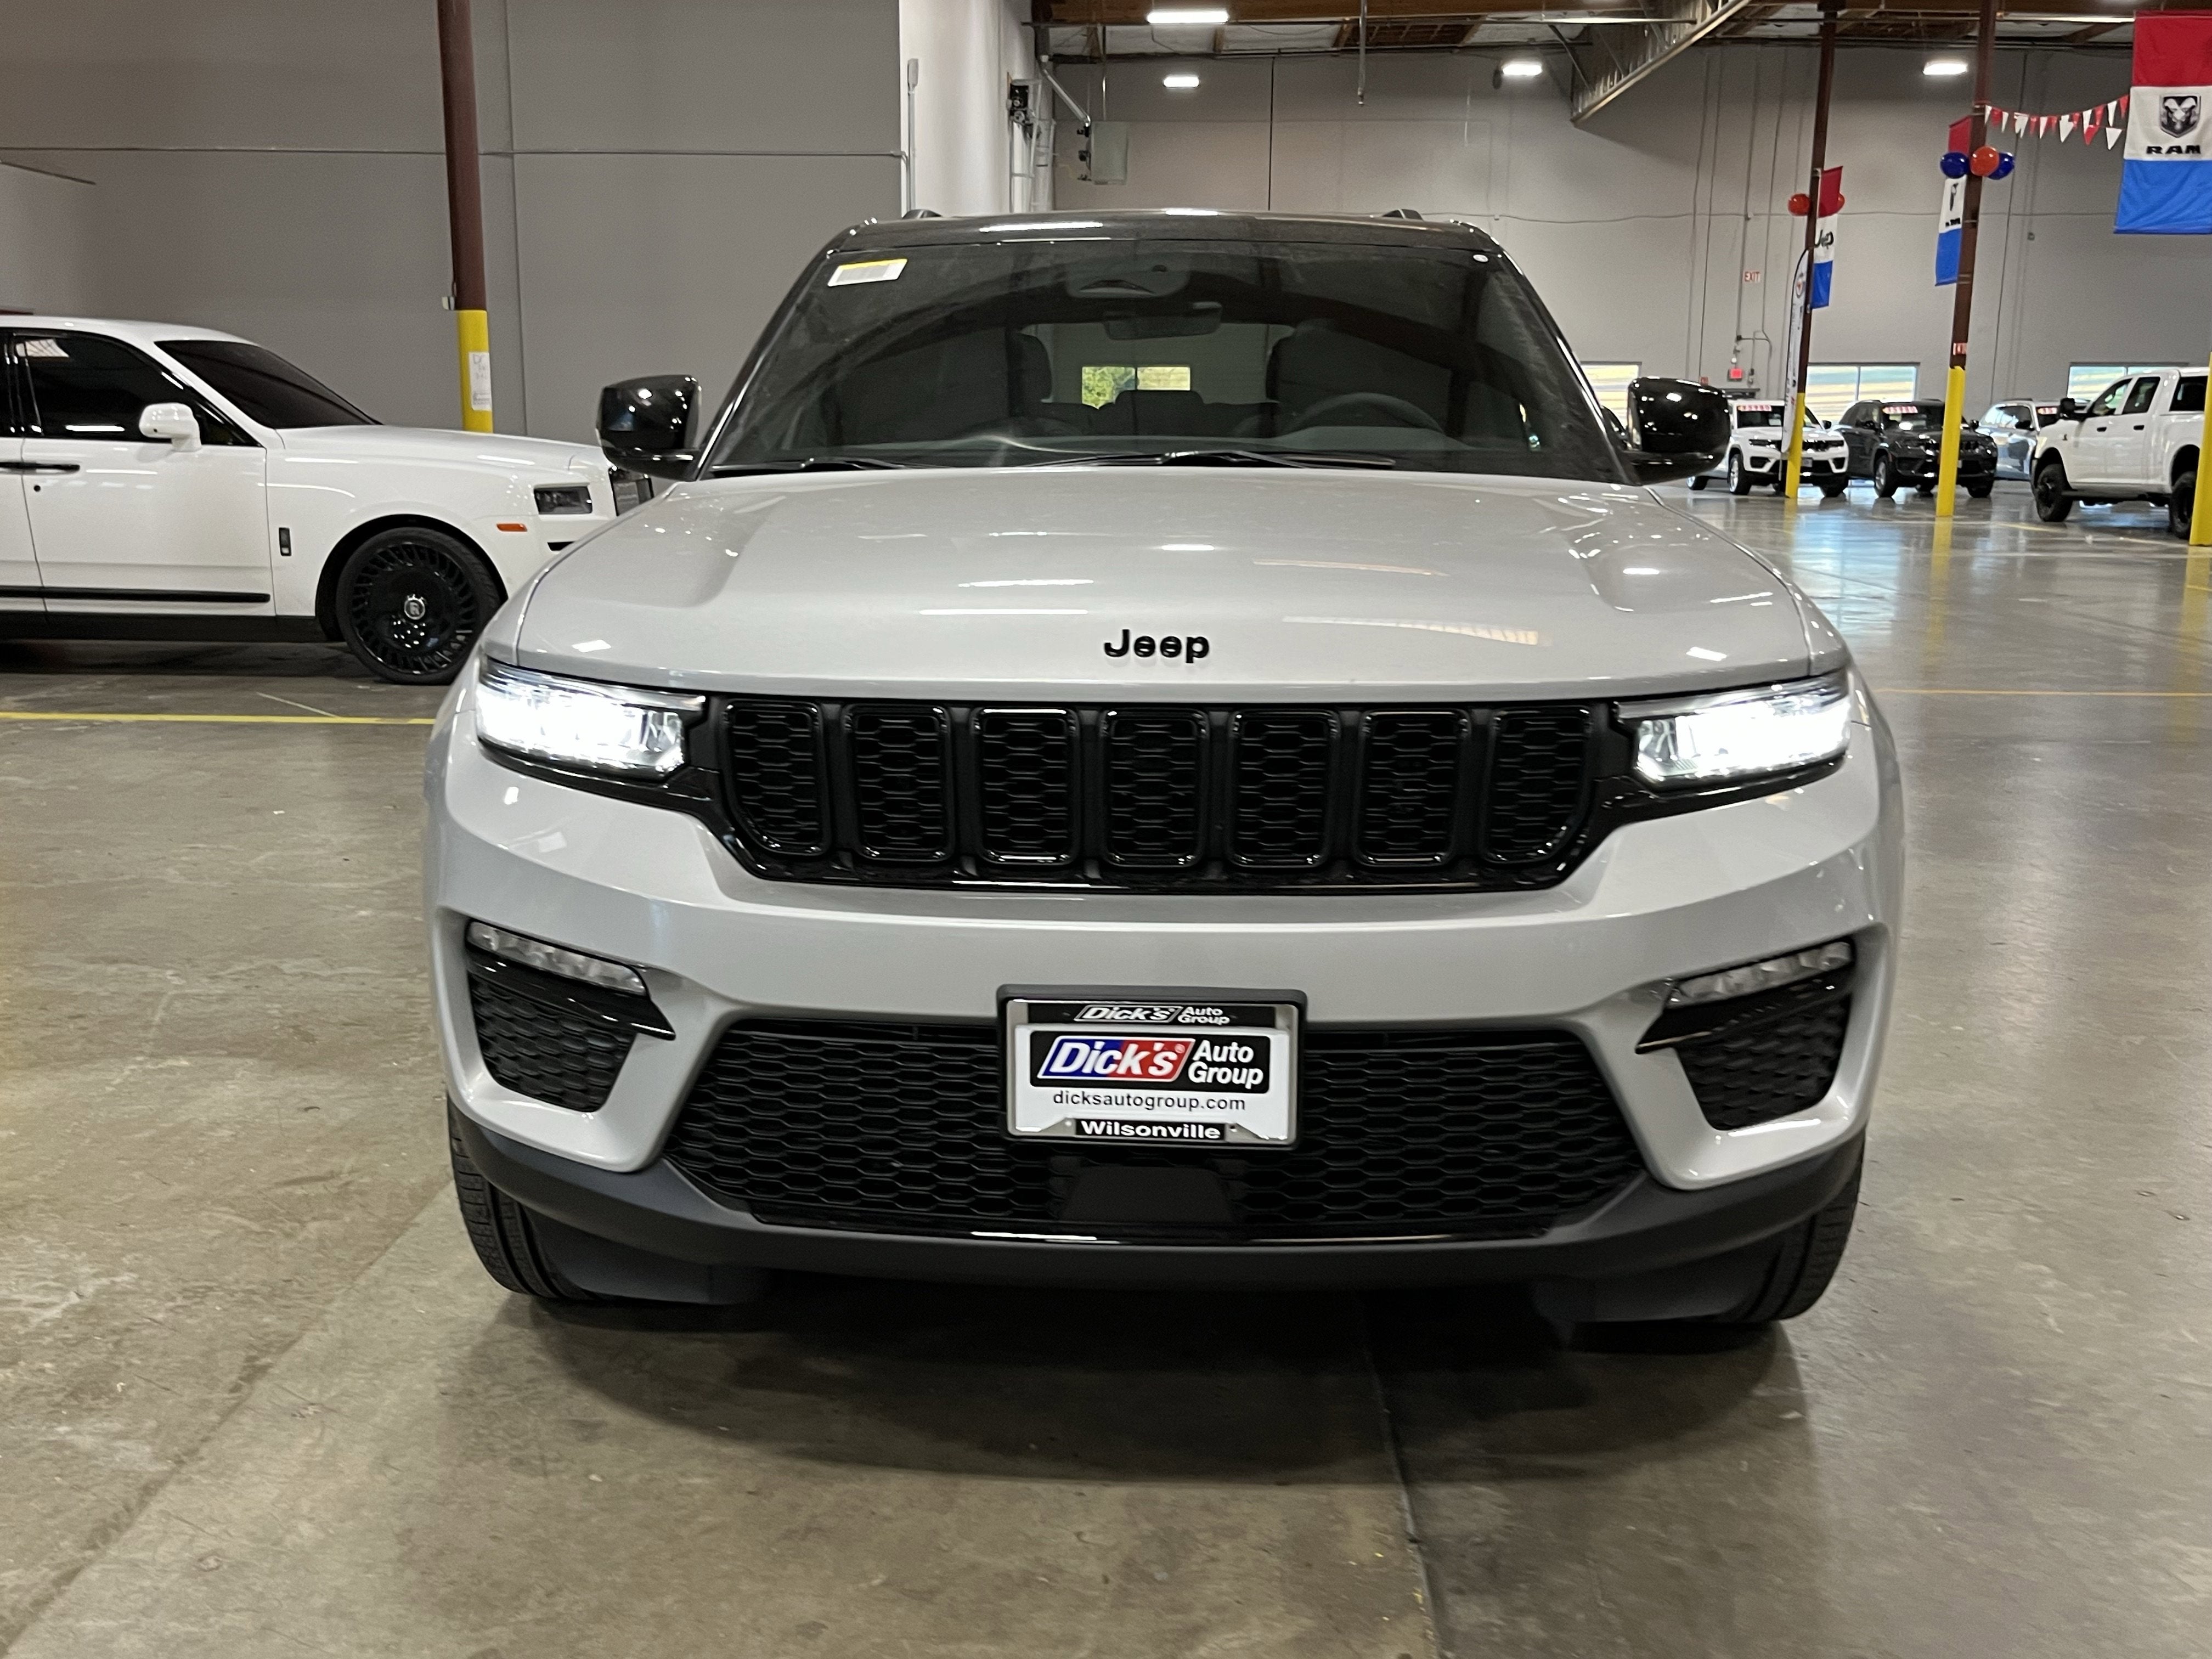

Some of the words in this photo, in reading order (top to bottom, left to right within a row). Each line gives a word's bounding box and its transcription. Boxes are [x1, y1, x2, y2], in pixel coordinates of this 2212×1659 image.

[2146, 145, 2201, 154] RAM
[1744, 272, 1760, 282] EXIT
[1104, 629, 1209, 663] Jeep
[1082, 1007, 1171, 1020] Dick's
[1182, 1006, 1223, 1016] Auto
[1177, 1014, 1231, 1025] Group
[1049, 1041, 1178, 1076] Dick's
[1192, 1040, 1254, 1063] Auto
[1188, 1062, 1263, 1089] Group
[1053, 1090, 1245, 1111] dicksautogroup.com
[1080, 1120, 1221, 1139] Wilsonville
